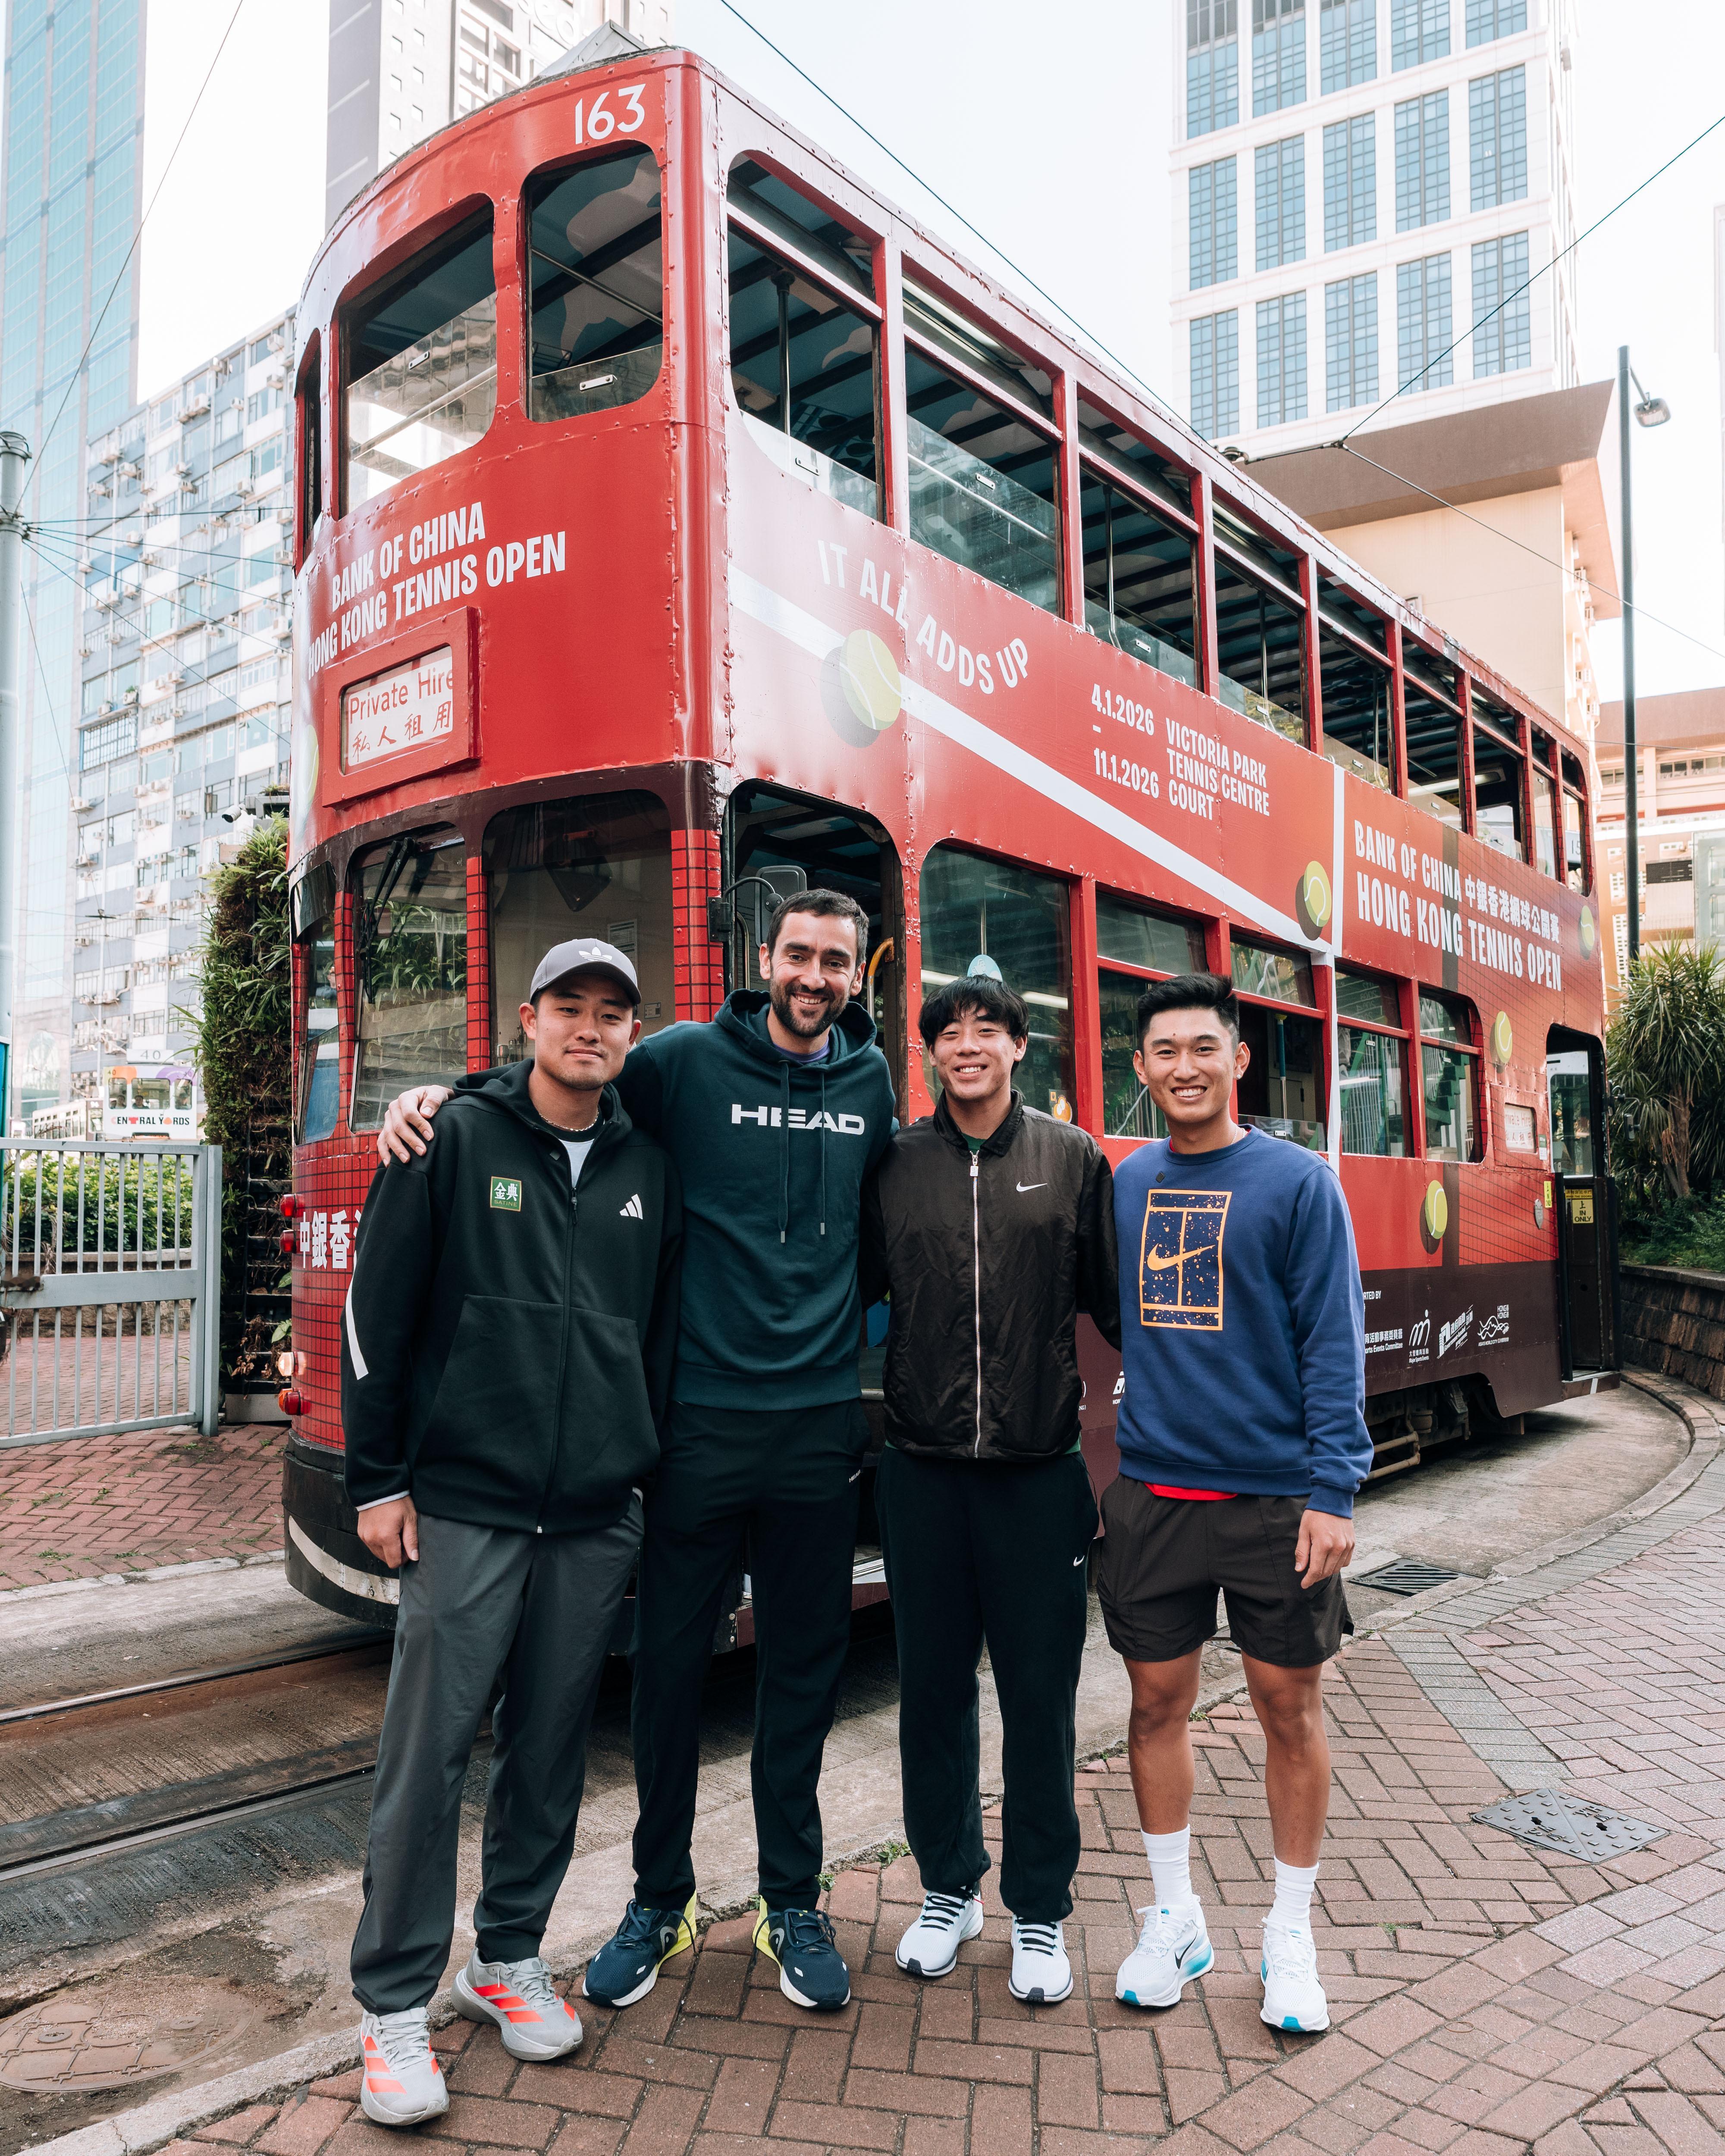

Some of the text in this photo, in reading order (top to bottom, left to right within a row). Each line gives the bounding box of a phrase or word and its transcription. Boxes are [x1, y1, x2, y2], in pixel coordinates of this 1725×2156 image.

[575, 83, 646, 145] 163
[332, 501, 486, 611] BANK OF CHINA
[308, 531, 566, 681] HONG KONG TENNIS OPEN
[818, 540, 1028, 694] IT ALL ADDS UP
[350, 669, 453, 724] Private Hire
[1091, 683, 1154, 736] 4.1.2026
[351, 701, 452, 763] 私人租用
[1166, 718, 1267, 788] VICTORIA PARK
[1094, 747, 1159, 799] 11.1.2026
[1167, 748, 1270, 816] TENNIS CENTRE
[1169, 779, 1214, 821] COURT
[1354, 820, 1559, 944] BANK OF CHINA 中銀香港網球公開賽
[1357, 871, 1562, 992] HONG KONG TENNIS OPEN
[140, 1050, 161, 1060] 40
[731, 1104, 865, 1135] HEAD
[1505, 1112, 1519, 1125] rivate
[494, 1182, 518, 1201] 金典
[1580, 1201, 1586, 1209] 上
[300, 1209, 361, 1269] 中銀香
[1363, 1291, 1381, 1300] RTED BY
[1364, 1329, 1403, 1344] 育活動事務委員會
[1365, 1346, 1373, 1354] orts
[1374, 1344, 1385, 1353] Events
[849, 1470, 860, 1483] HEAD
